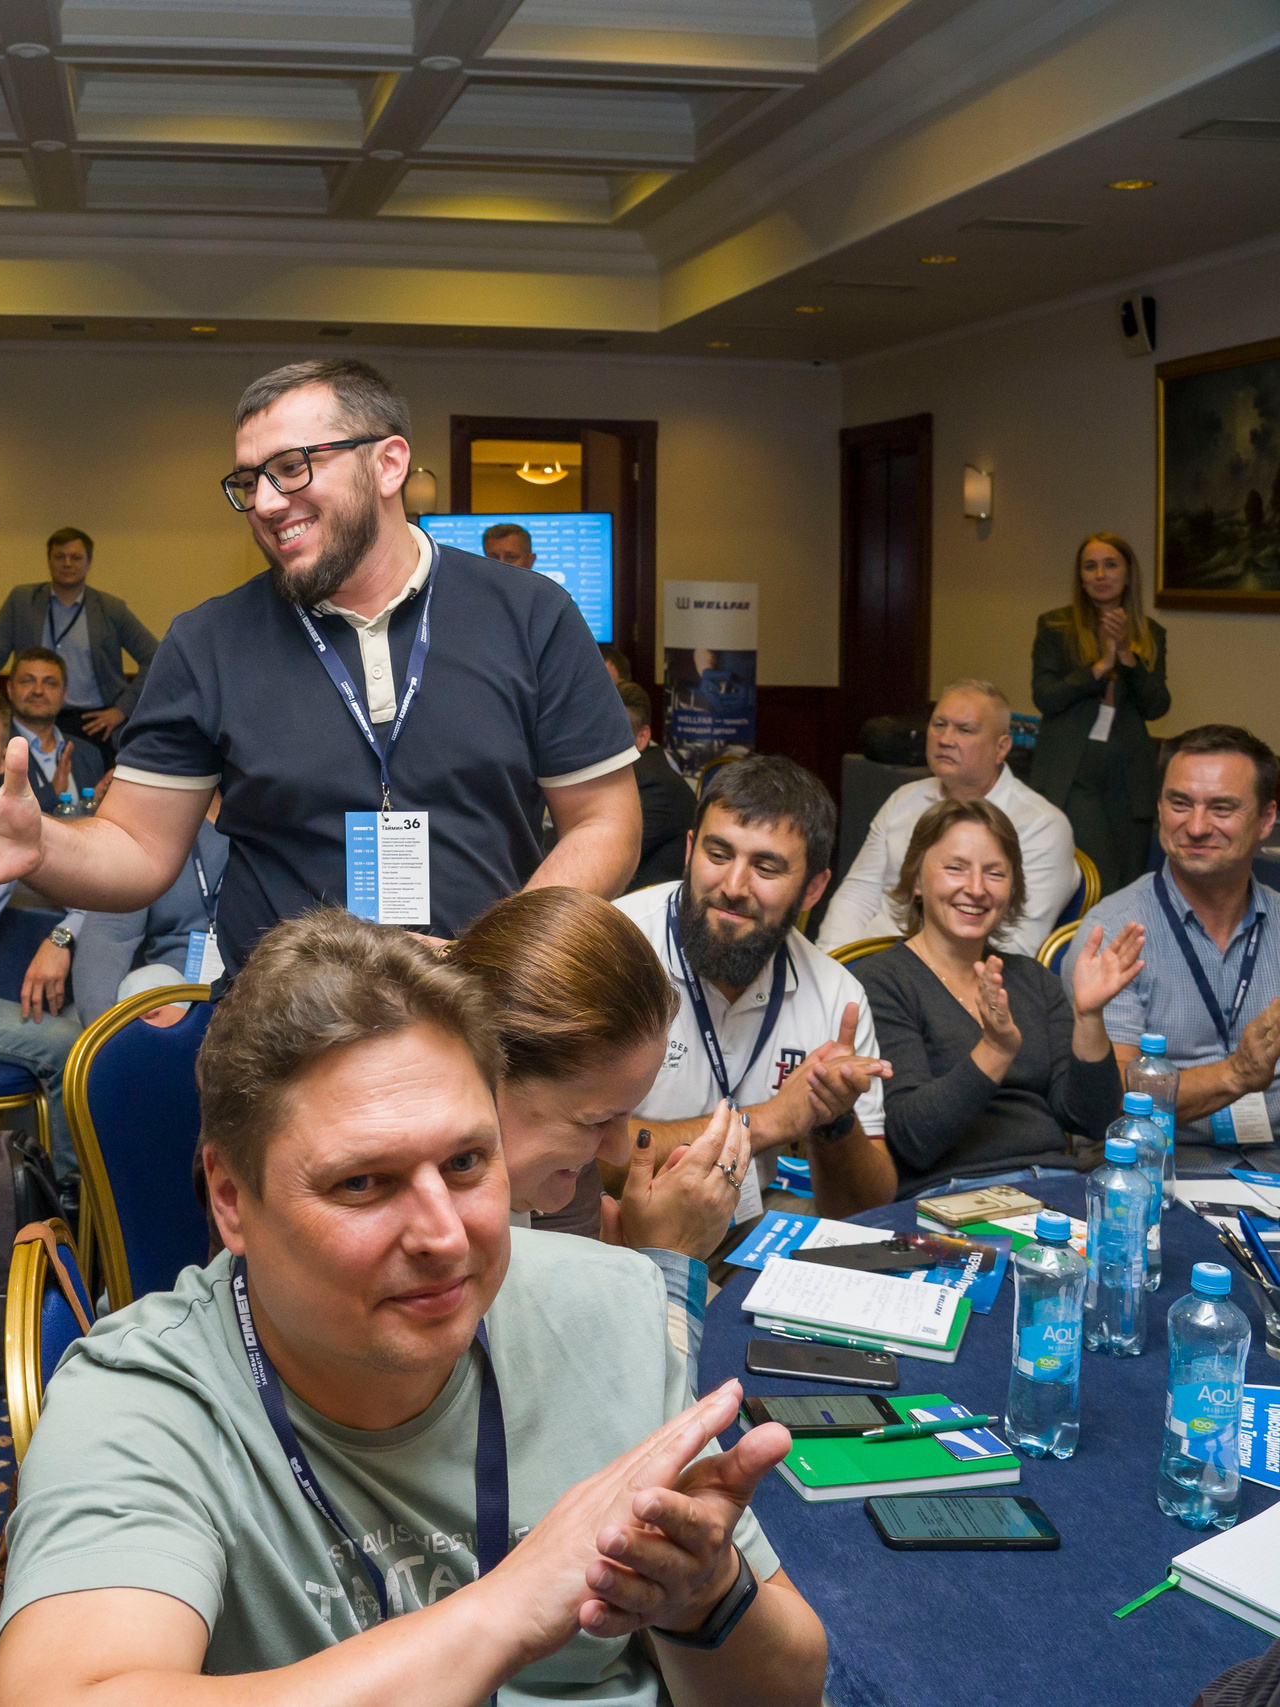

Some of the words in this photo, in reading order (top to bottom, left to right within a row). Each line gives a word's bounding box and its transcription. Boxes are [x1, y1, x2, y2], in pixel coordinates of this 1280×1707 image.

[693, 601, 750, 610] WELLFAR
[403, 818, 421, 830] 36
[935, 1293, 946, 1316] WELLFAR
[1241, 1403, 1255, 1421] нам
[1240, 1430, 1257, 1468] Телеграм
